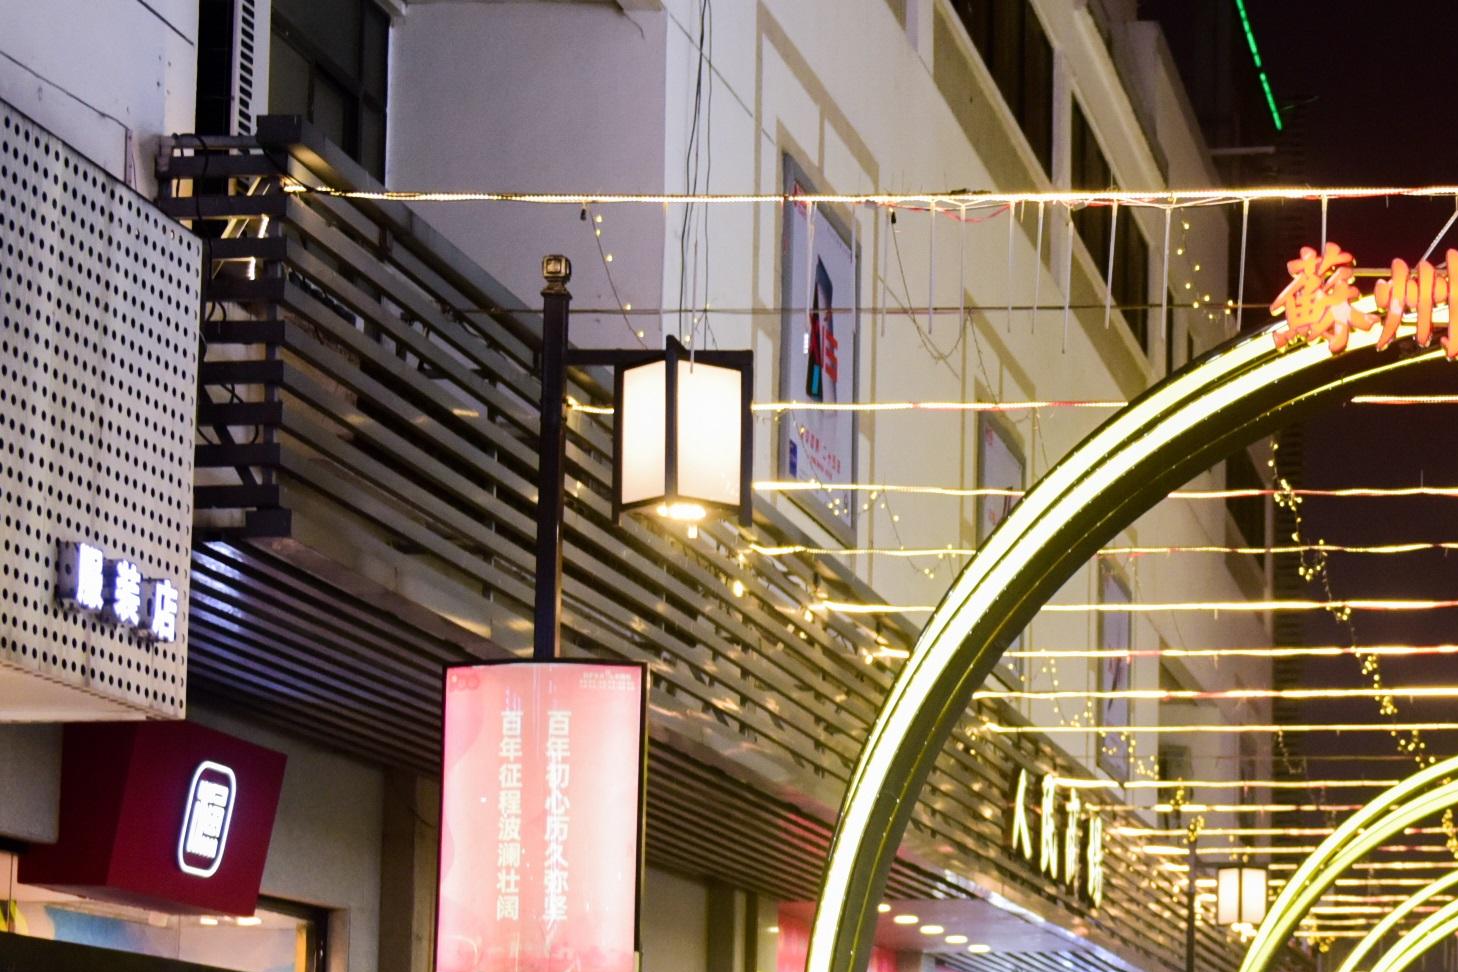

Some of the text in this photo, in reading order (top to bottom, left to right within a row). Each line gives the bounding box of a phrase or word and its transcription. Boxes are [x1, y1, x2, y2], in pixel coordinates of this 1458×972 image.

[77, 542, 179, 642] 服装店
[496, 711, 523, 921] 百年征程波澜壮阔
[543, 711, 572, 921] 百年初心历久弥坚
